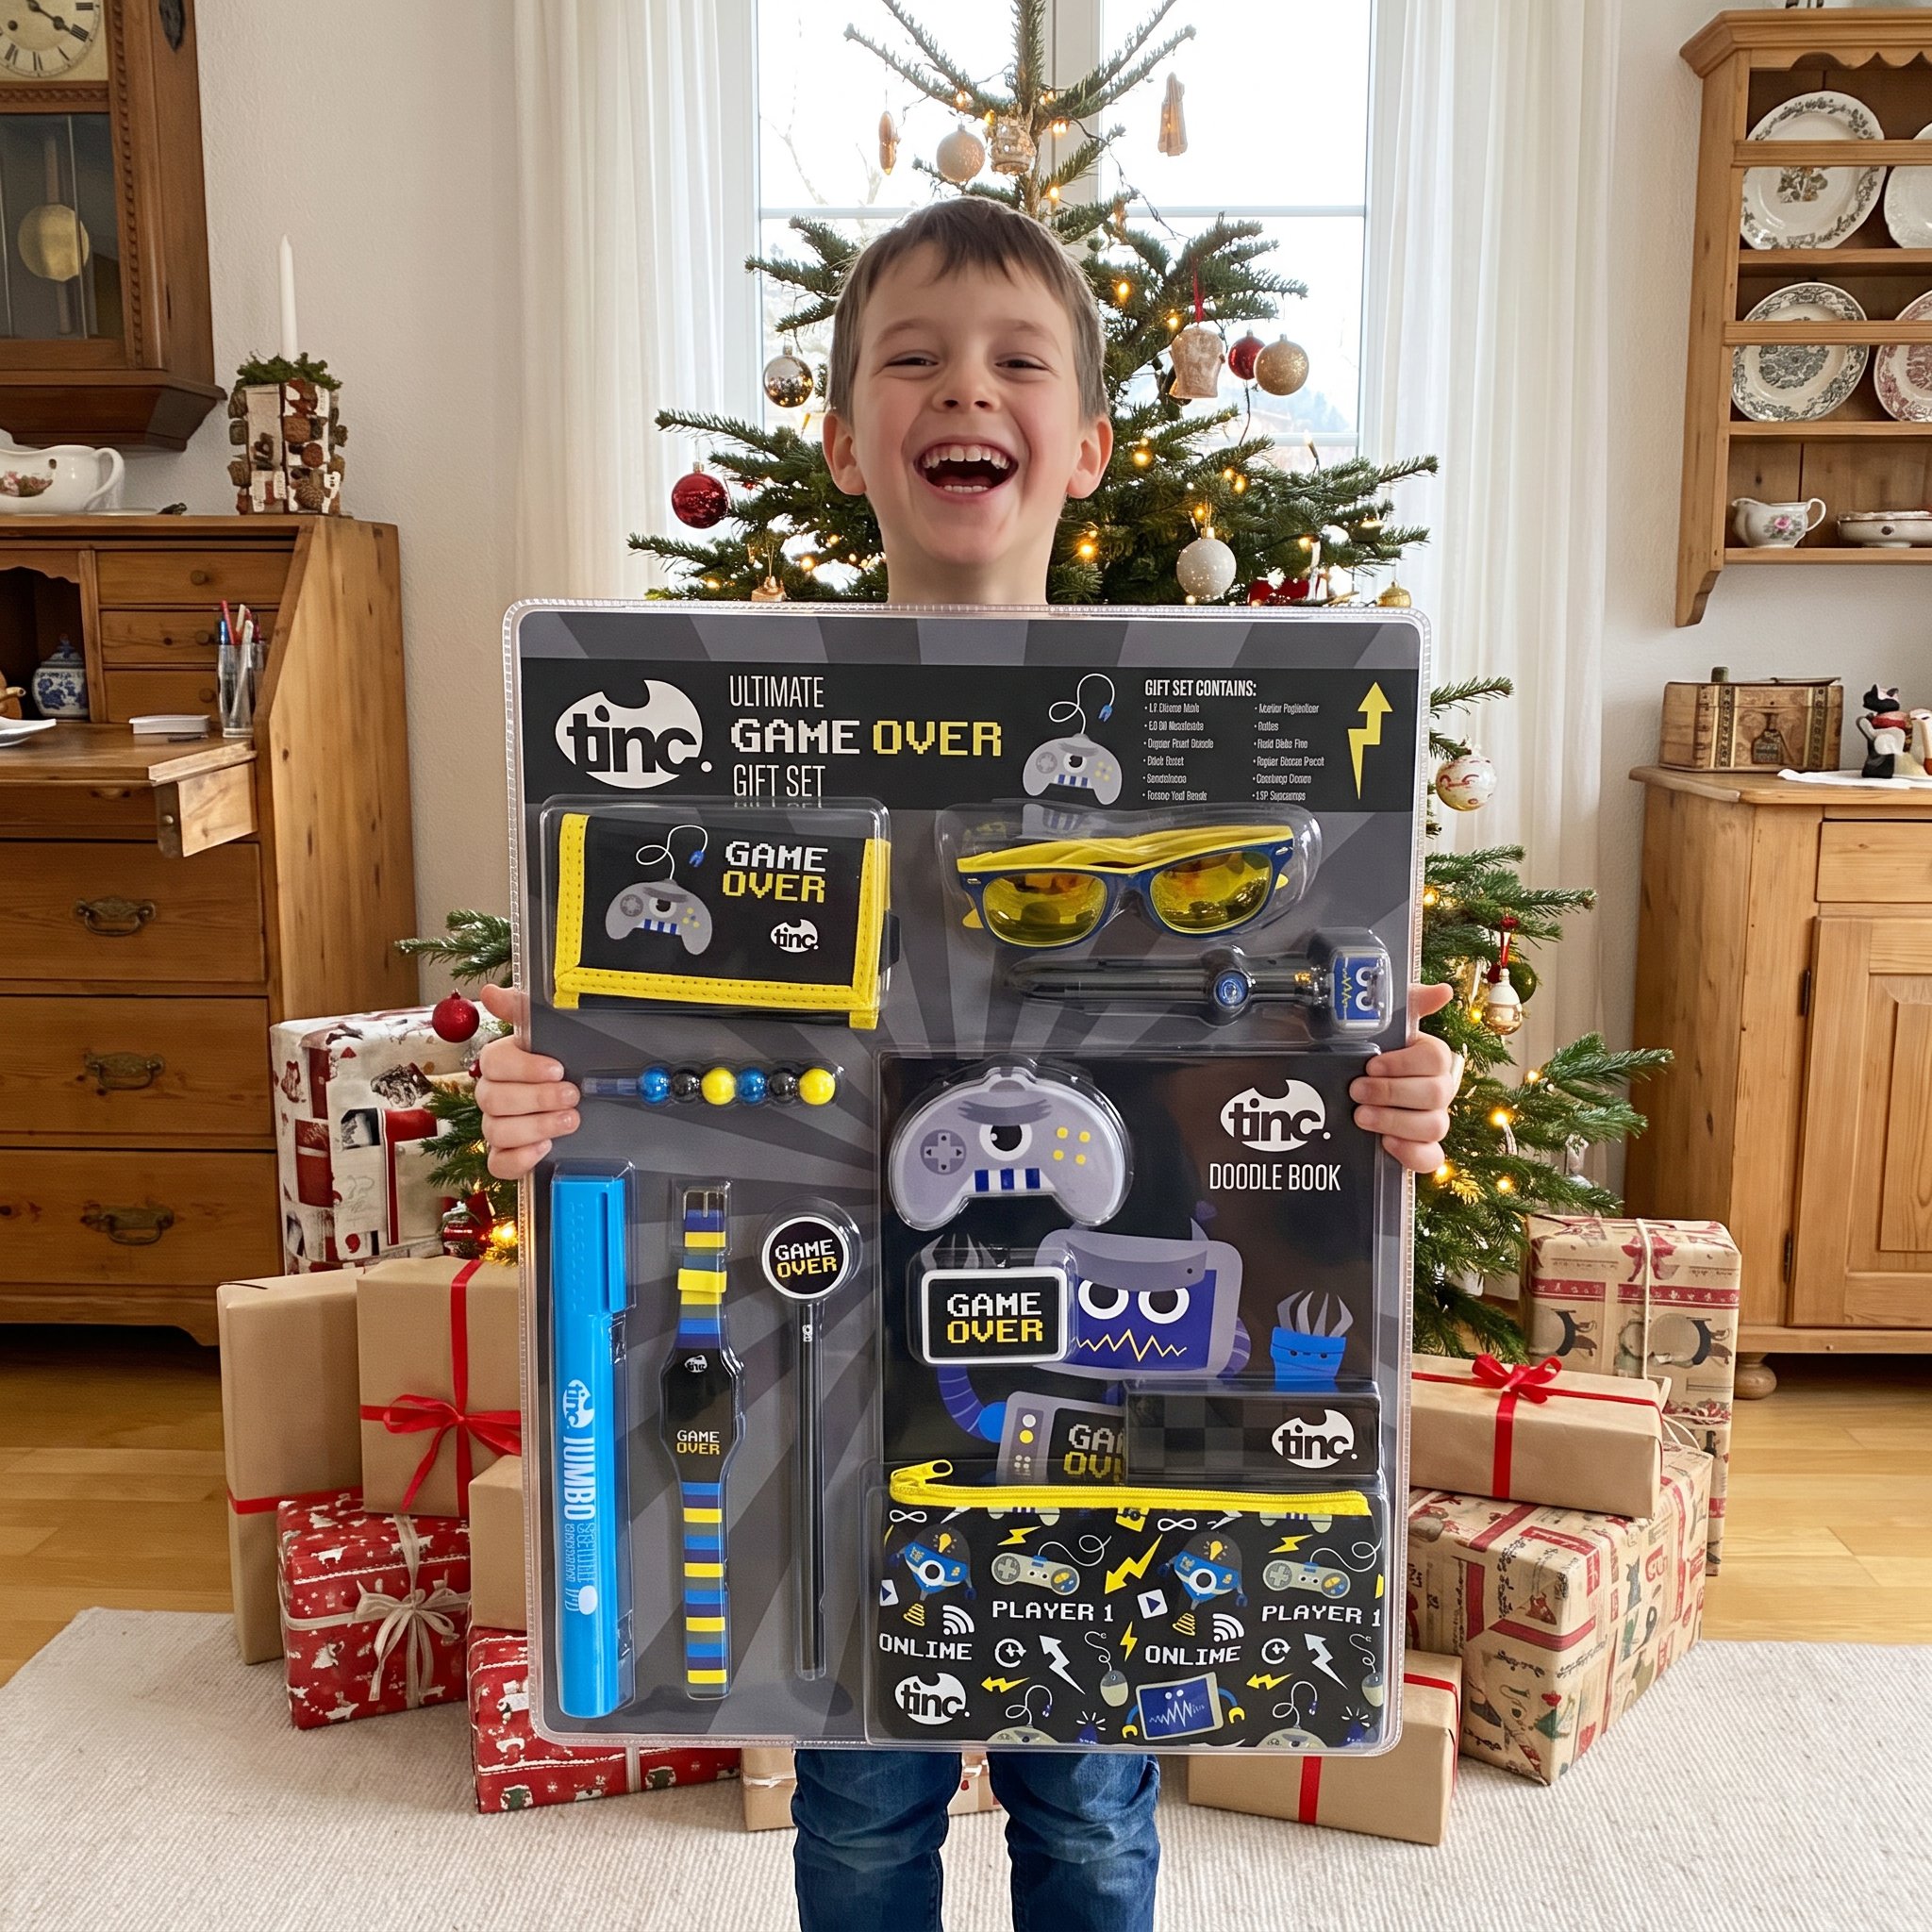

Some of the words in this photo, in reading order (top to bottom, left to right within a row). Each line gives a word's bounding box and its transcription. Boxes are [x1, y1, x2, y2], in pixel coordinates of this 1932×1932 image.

[730, 675, 824, 708] ULTIMATE
[1144, 679, 1170, 696] GIFT
[1173, 679, 1194, 696] SET
[1195, 679, 1257, 697] CONTAINS:
[730, 719, 860, 755] GAME
[873, 720, 1002, 756] OVER
[733, 764, 779, 796] GIFT
[786, 765, 826, 797] SET
[725, 841, 828, 873] GAME
[723, 870, 825, 903] OVER
[1209, 1163, 1283, 1191] DOODLE
[1289, 1164, 1341, 1191] BOOK
[774, 1239, 836, 1261] GAME
[776, 1256, 838, 1278] OVER
[947, 1292, 1042, 1317] GAME
[947, 1319, 1043, 1343] OVER
[676, 1429, 720, 1443] GAME
[676, 1441, 721, 1456] OVER
[562, 1436, 596, 1521] JUMBO
[992, 1600, 1094, 1622] PLAYER
[1104, 1604, 1114, 1623] 1
[1261, 1606, 1362, 1624] PLAYER
[1372, 1609, 1381, 1627] 1
[878, 1633, 973, 1660] ONLIME
[1145, 1645, 1241, 1666] ONLIME
